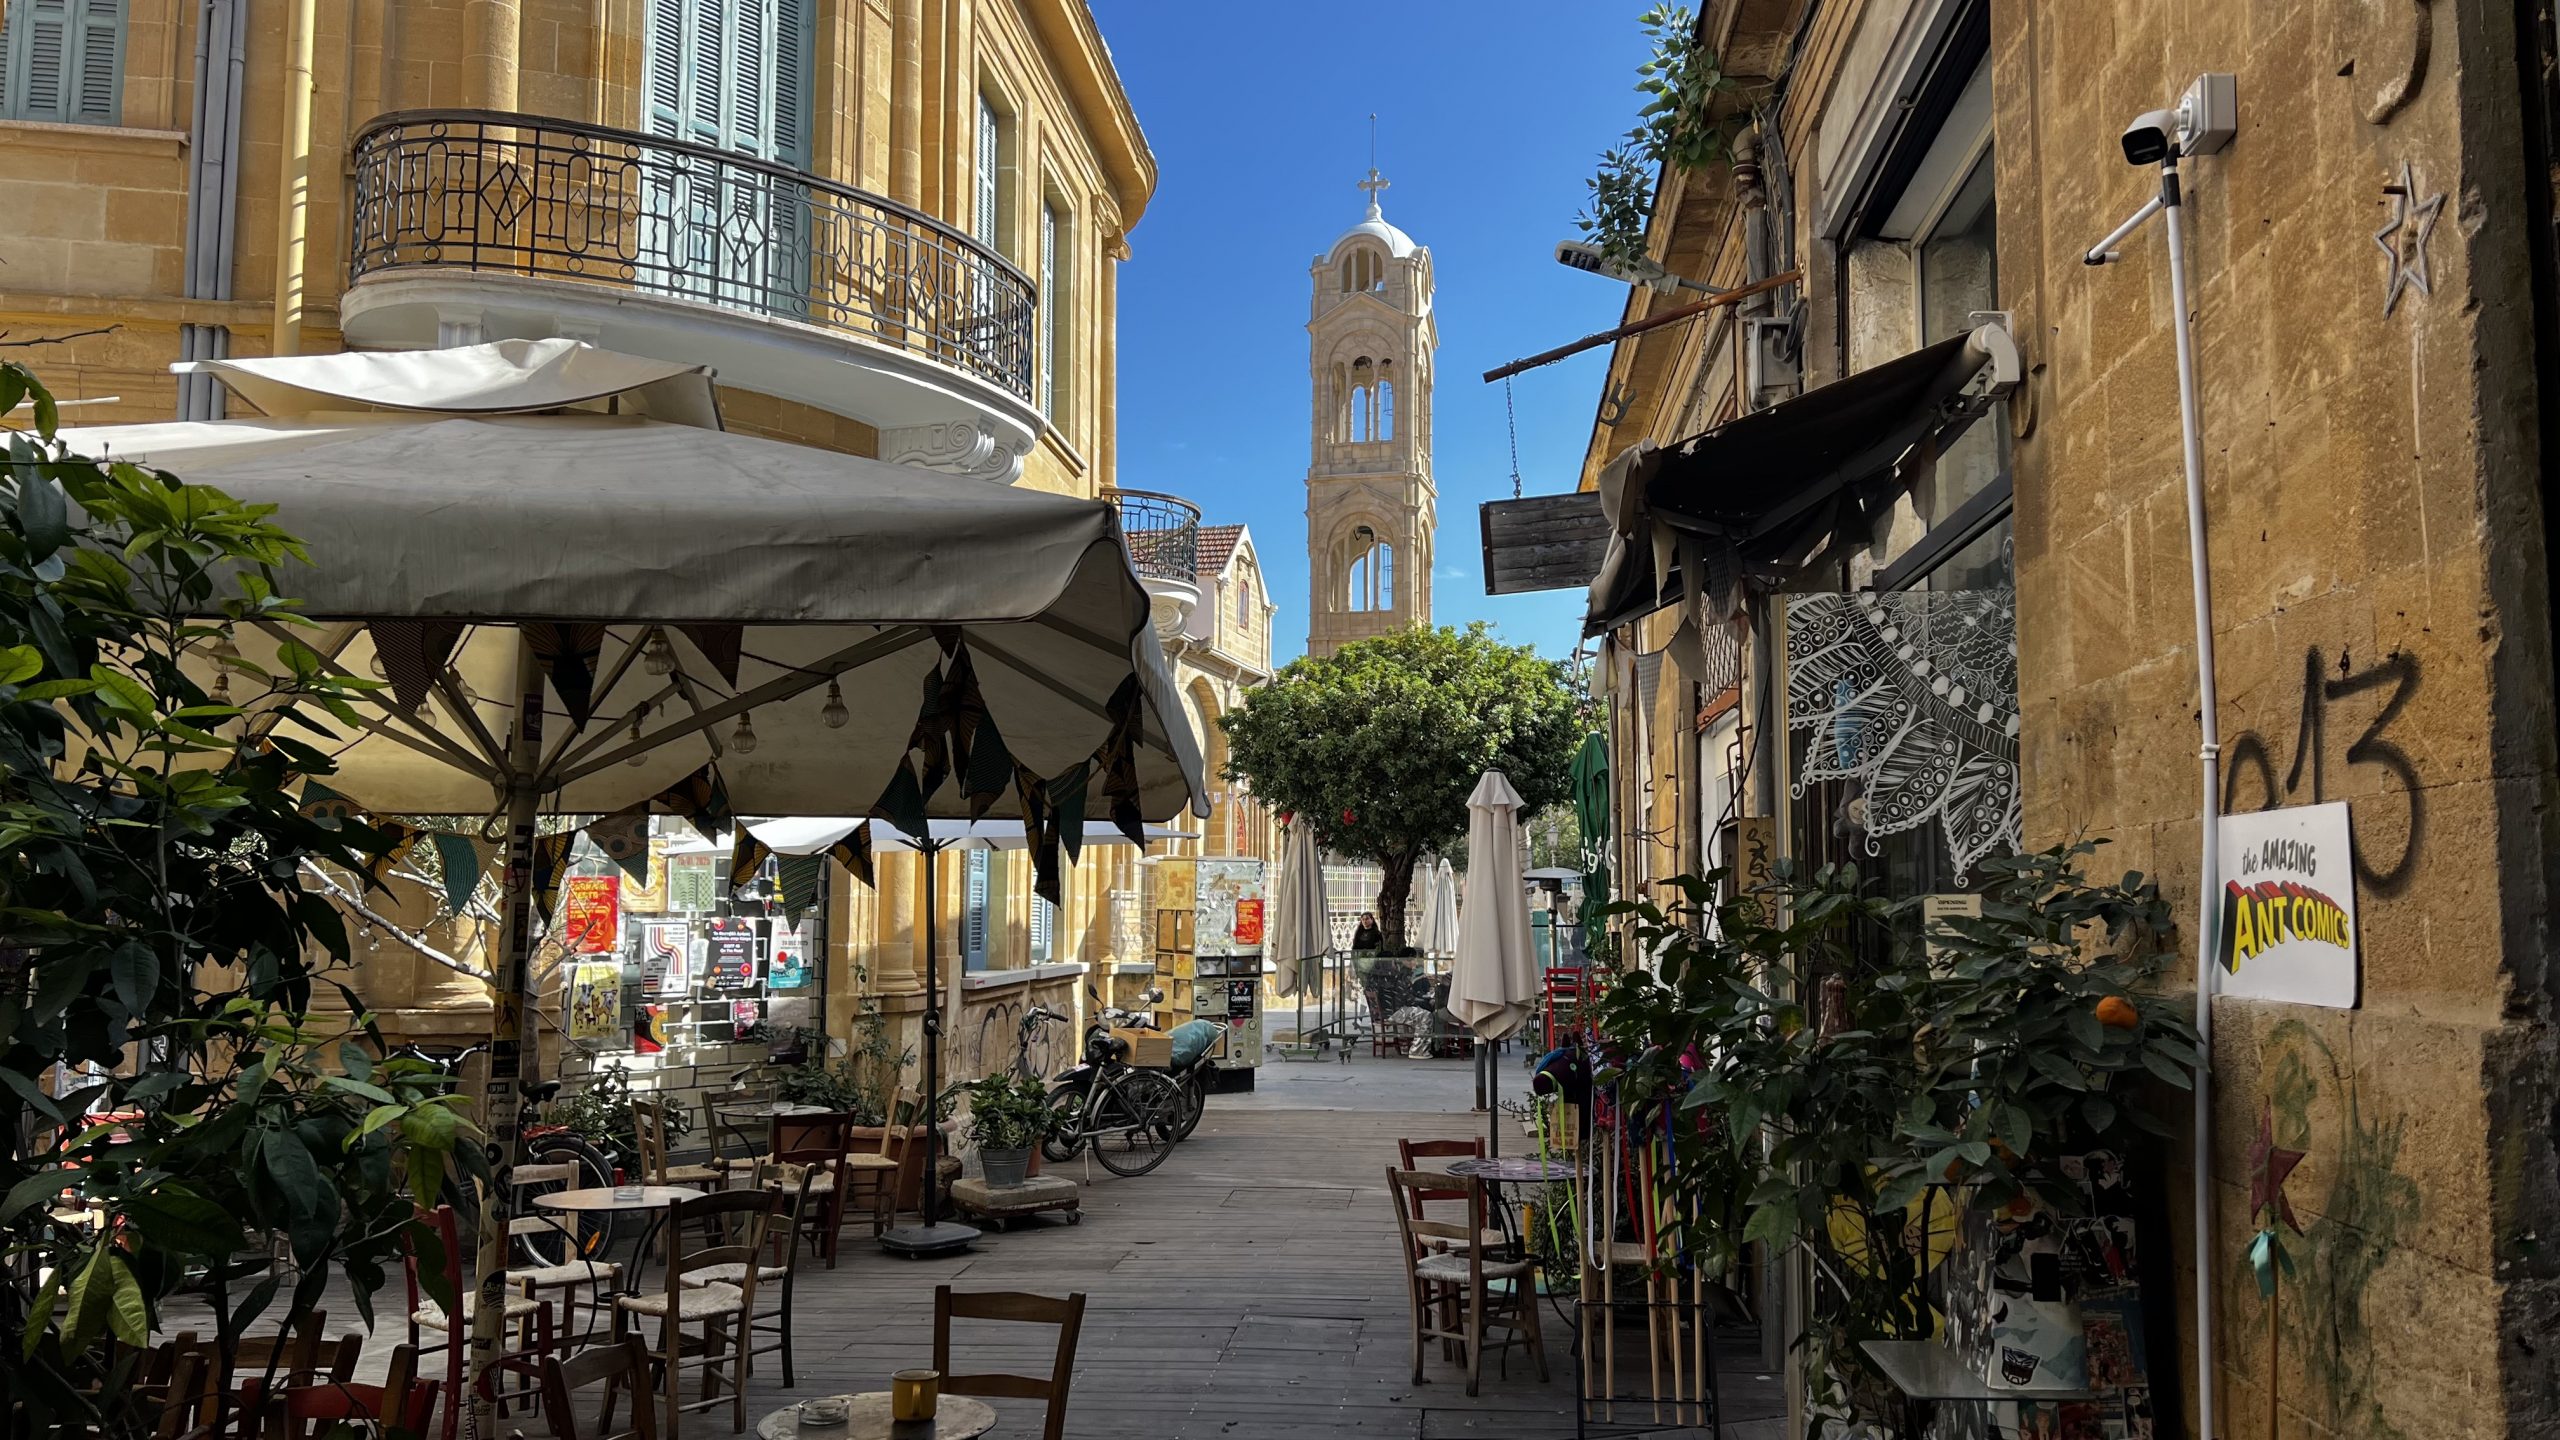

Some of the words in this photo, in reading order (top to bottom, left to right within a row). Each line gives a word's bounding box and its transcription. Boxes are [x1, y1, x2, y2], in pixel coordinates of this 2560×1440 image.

[2242, 847, 2258, 876] the
[2261, 837, 2317, 878] AMAZING
[2224, 886, 2288, 976] ANT
[2287, 889, 2350, 950] COMICS
